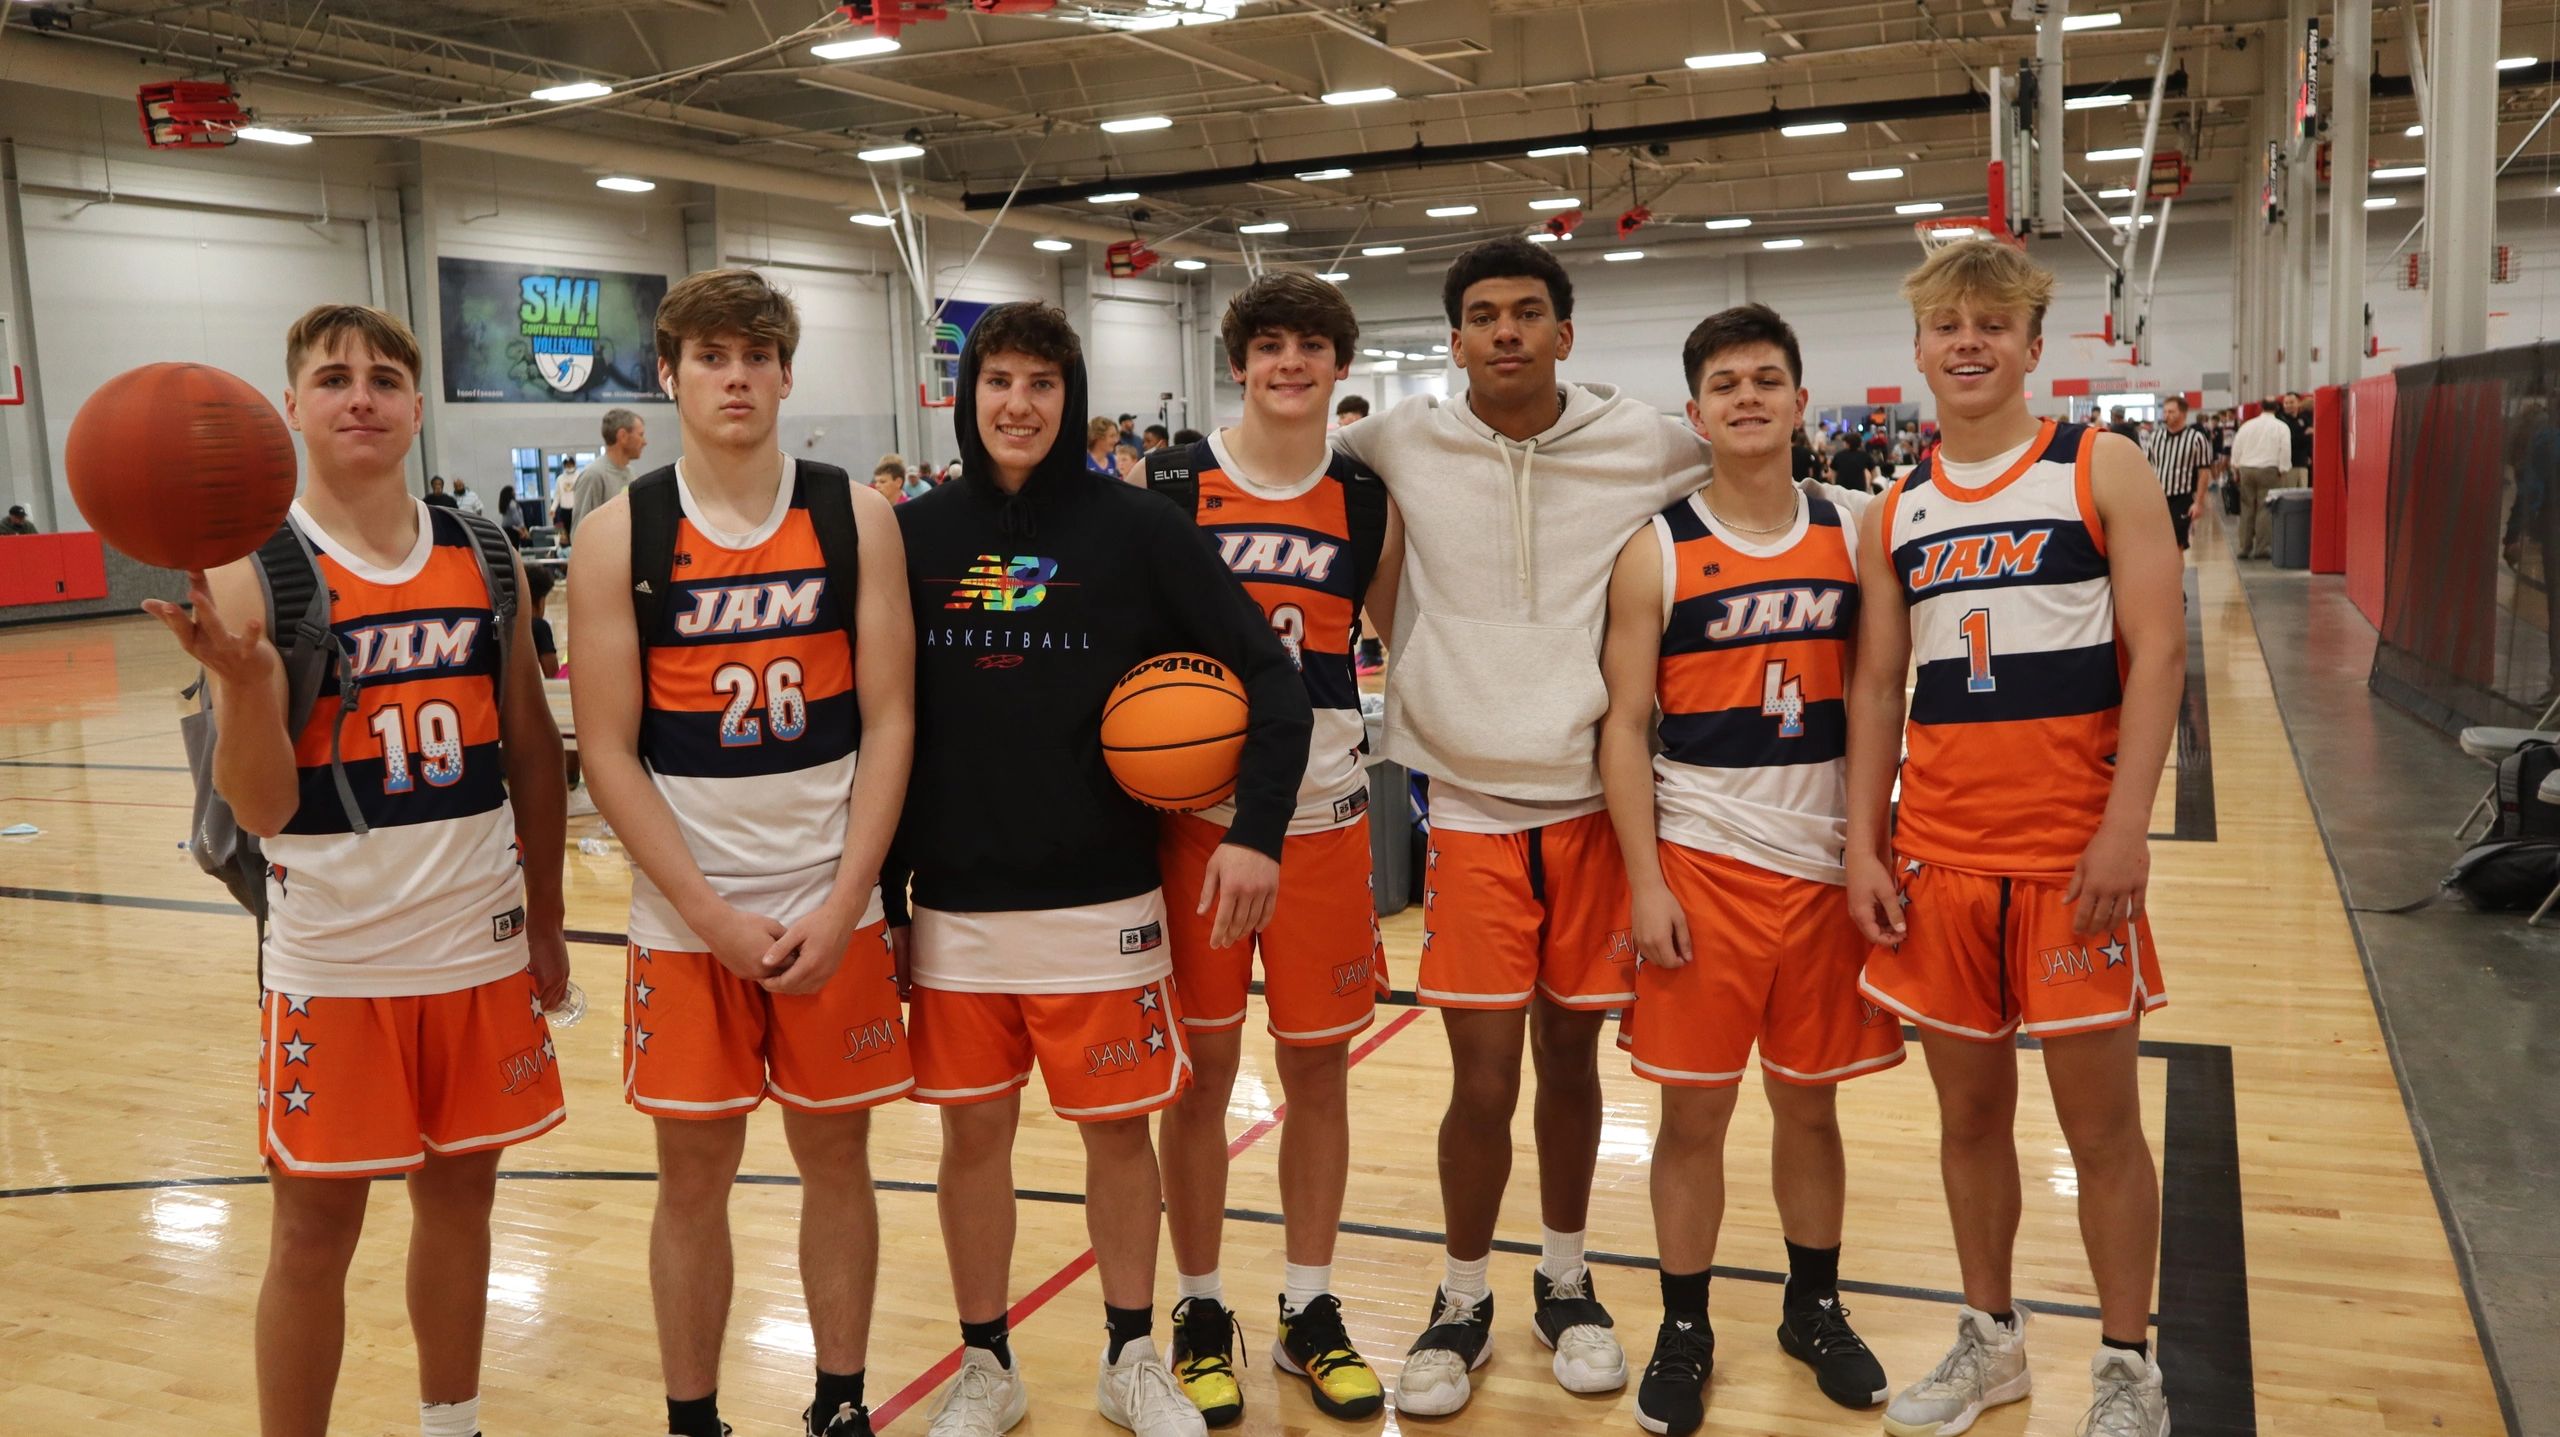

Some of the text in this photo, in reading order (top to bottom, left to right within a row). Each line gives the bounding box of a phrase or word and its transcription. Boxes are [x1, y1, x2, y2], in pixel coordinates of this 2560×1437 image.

[520, 275, 599, 326] SWI
[521, 323, 598, 338] SOUTHWEST IOWA
[533, 336, 593, 355] VOLLEYBALL
[1154, 469, 1189, 480] ELITE
[1909, 528, 2053, 593] JAM
[674, 577, 826, 638] JAM
[1704, 587, 1843, 642] JAM
[334, 618, 480, 680] JAM
[927, 628, 1089, 650] ASKETBALL
[1960, 608, 1996, 693] 1
[1119, 656, 1225, 688] Wilson
[711, 656, 807, 748] 26
[1761, 659, 1806, 738] 4
[368, 699, 464, 795] 19
[1605, 931, 1635, 960] JA
[2040, 945, 2094, 982] JAM
[1331, 957, 1370, 994] JAM
[845, 1018, 896, 1060] JAM
[1085, 1039, 1140, 1075] JAM
[501, 1047, 544, 1093] JAM
